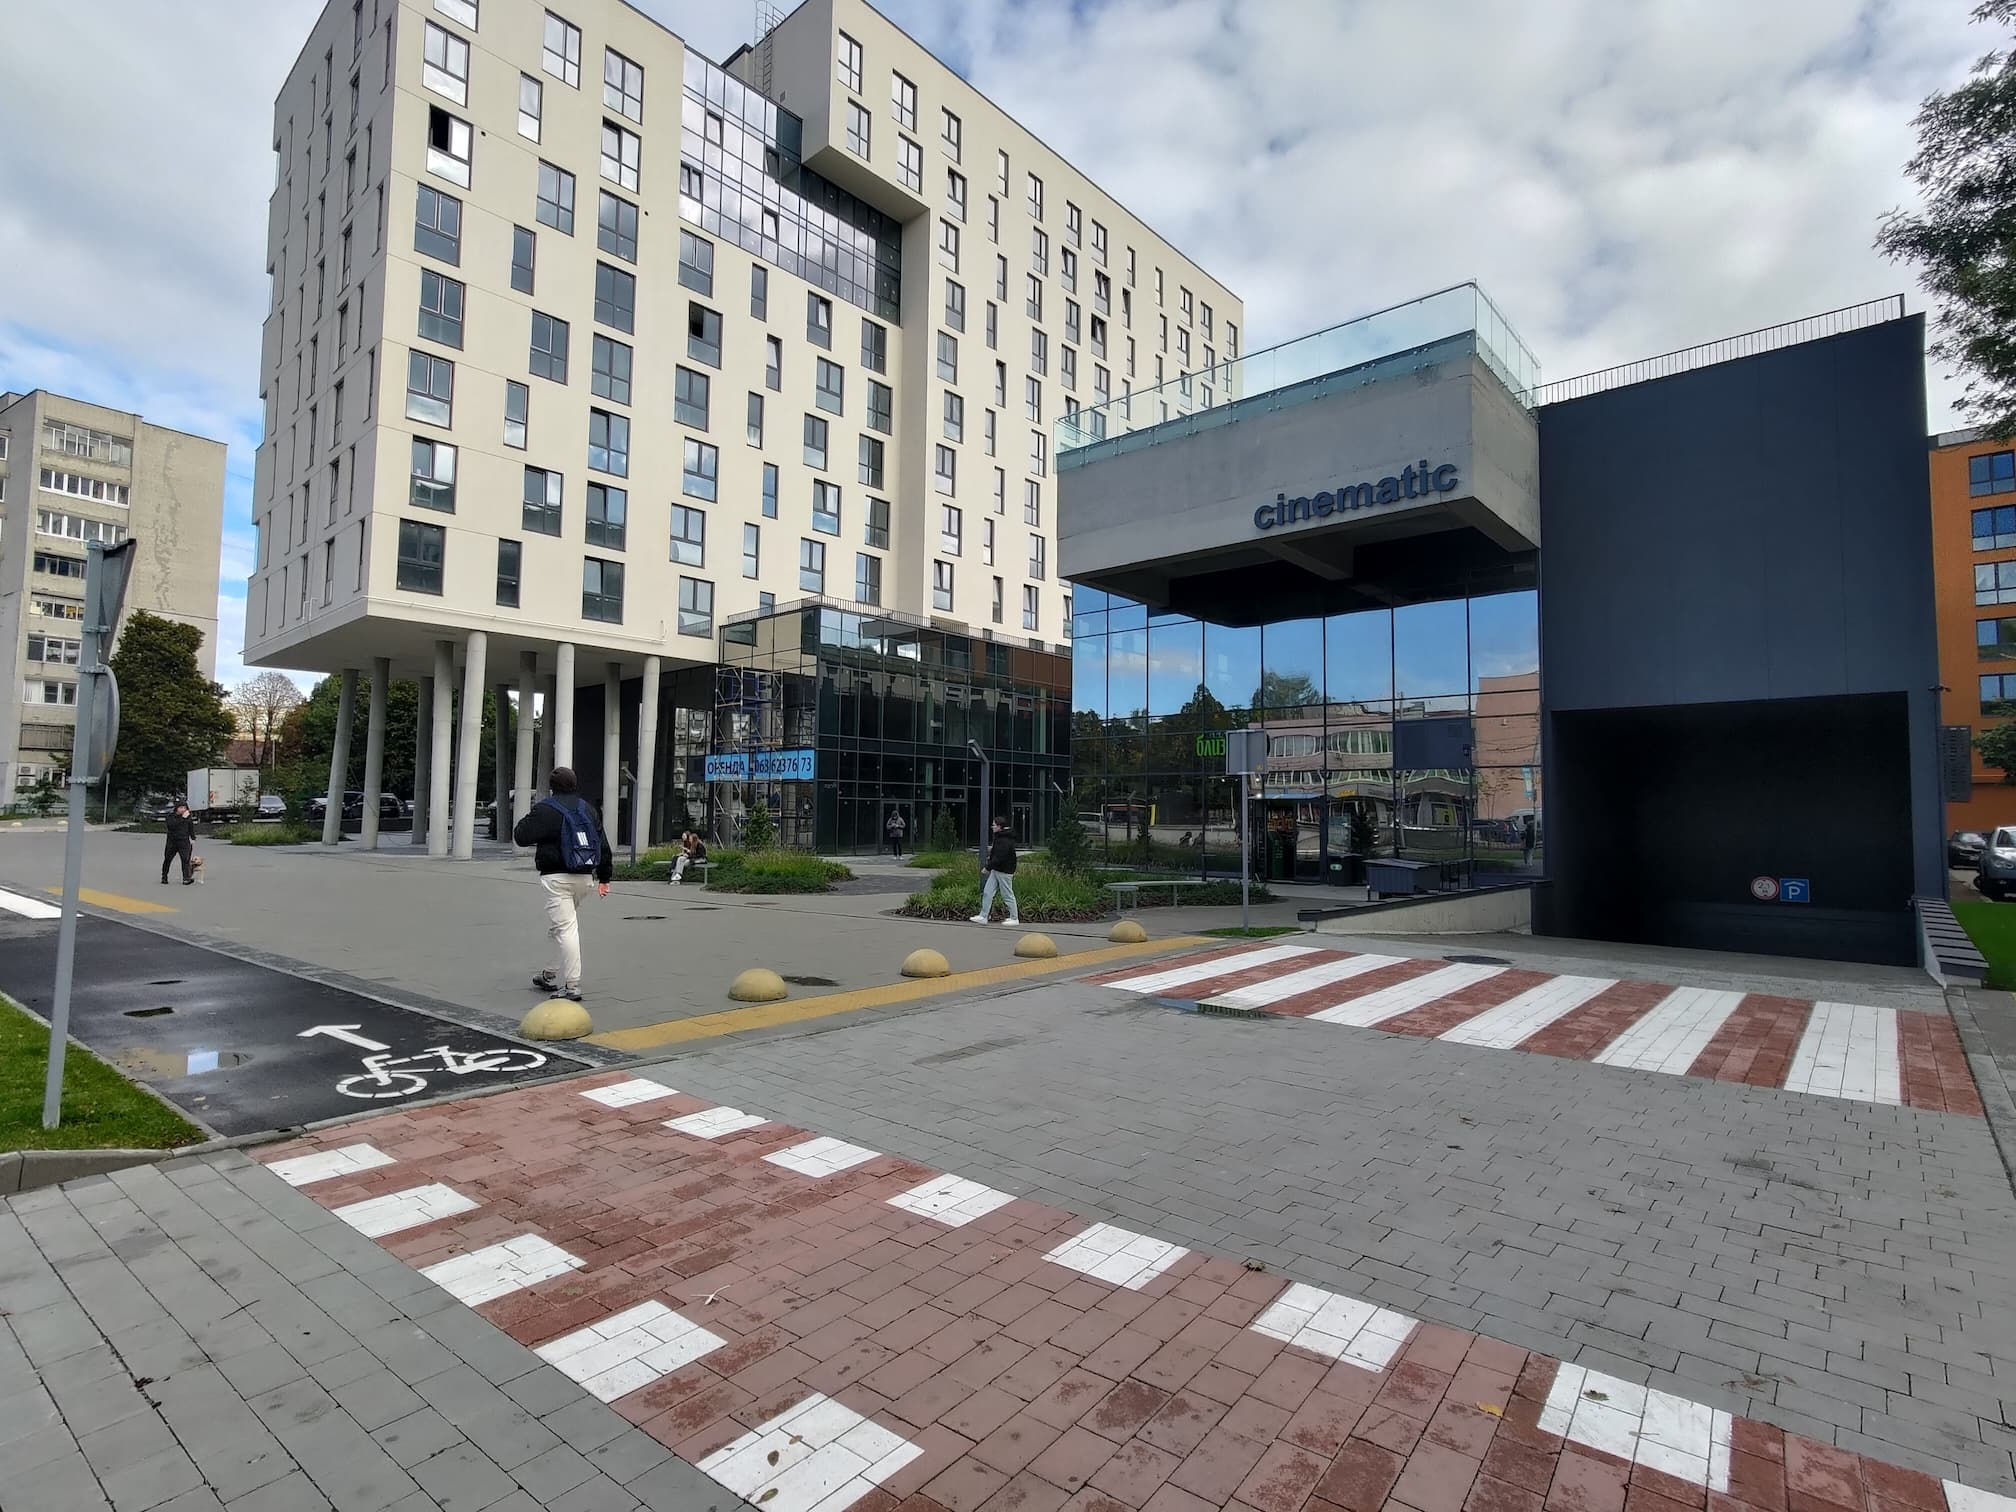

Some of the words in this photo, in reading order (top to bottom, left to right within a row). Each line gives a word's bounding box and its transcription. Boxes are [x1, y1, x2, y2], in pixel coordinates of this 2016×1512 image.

[1254, 459, 1458, 530] cinematic
[707, 760, 745, 775] ОРЕНДА
[1788, 886, 1801, 899] P
